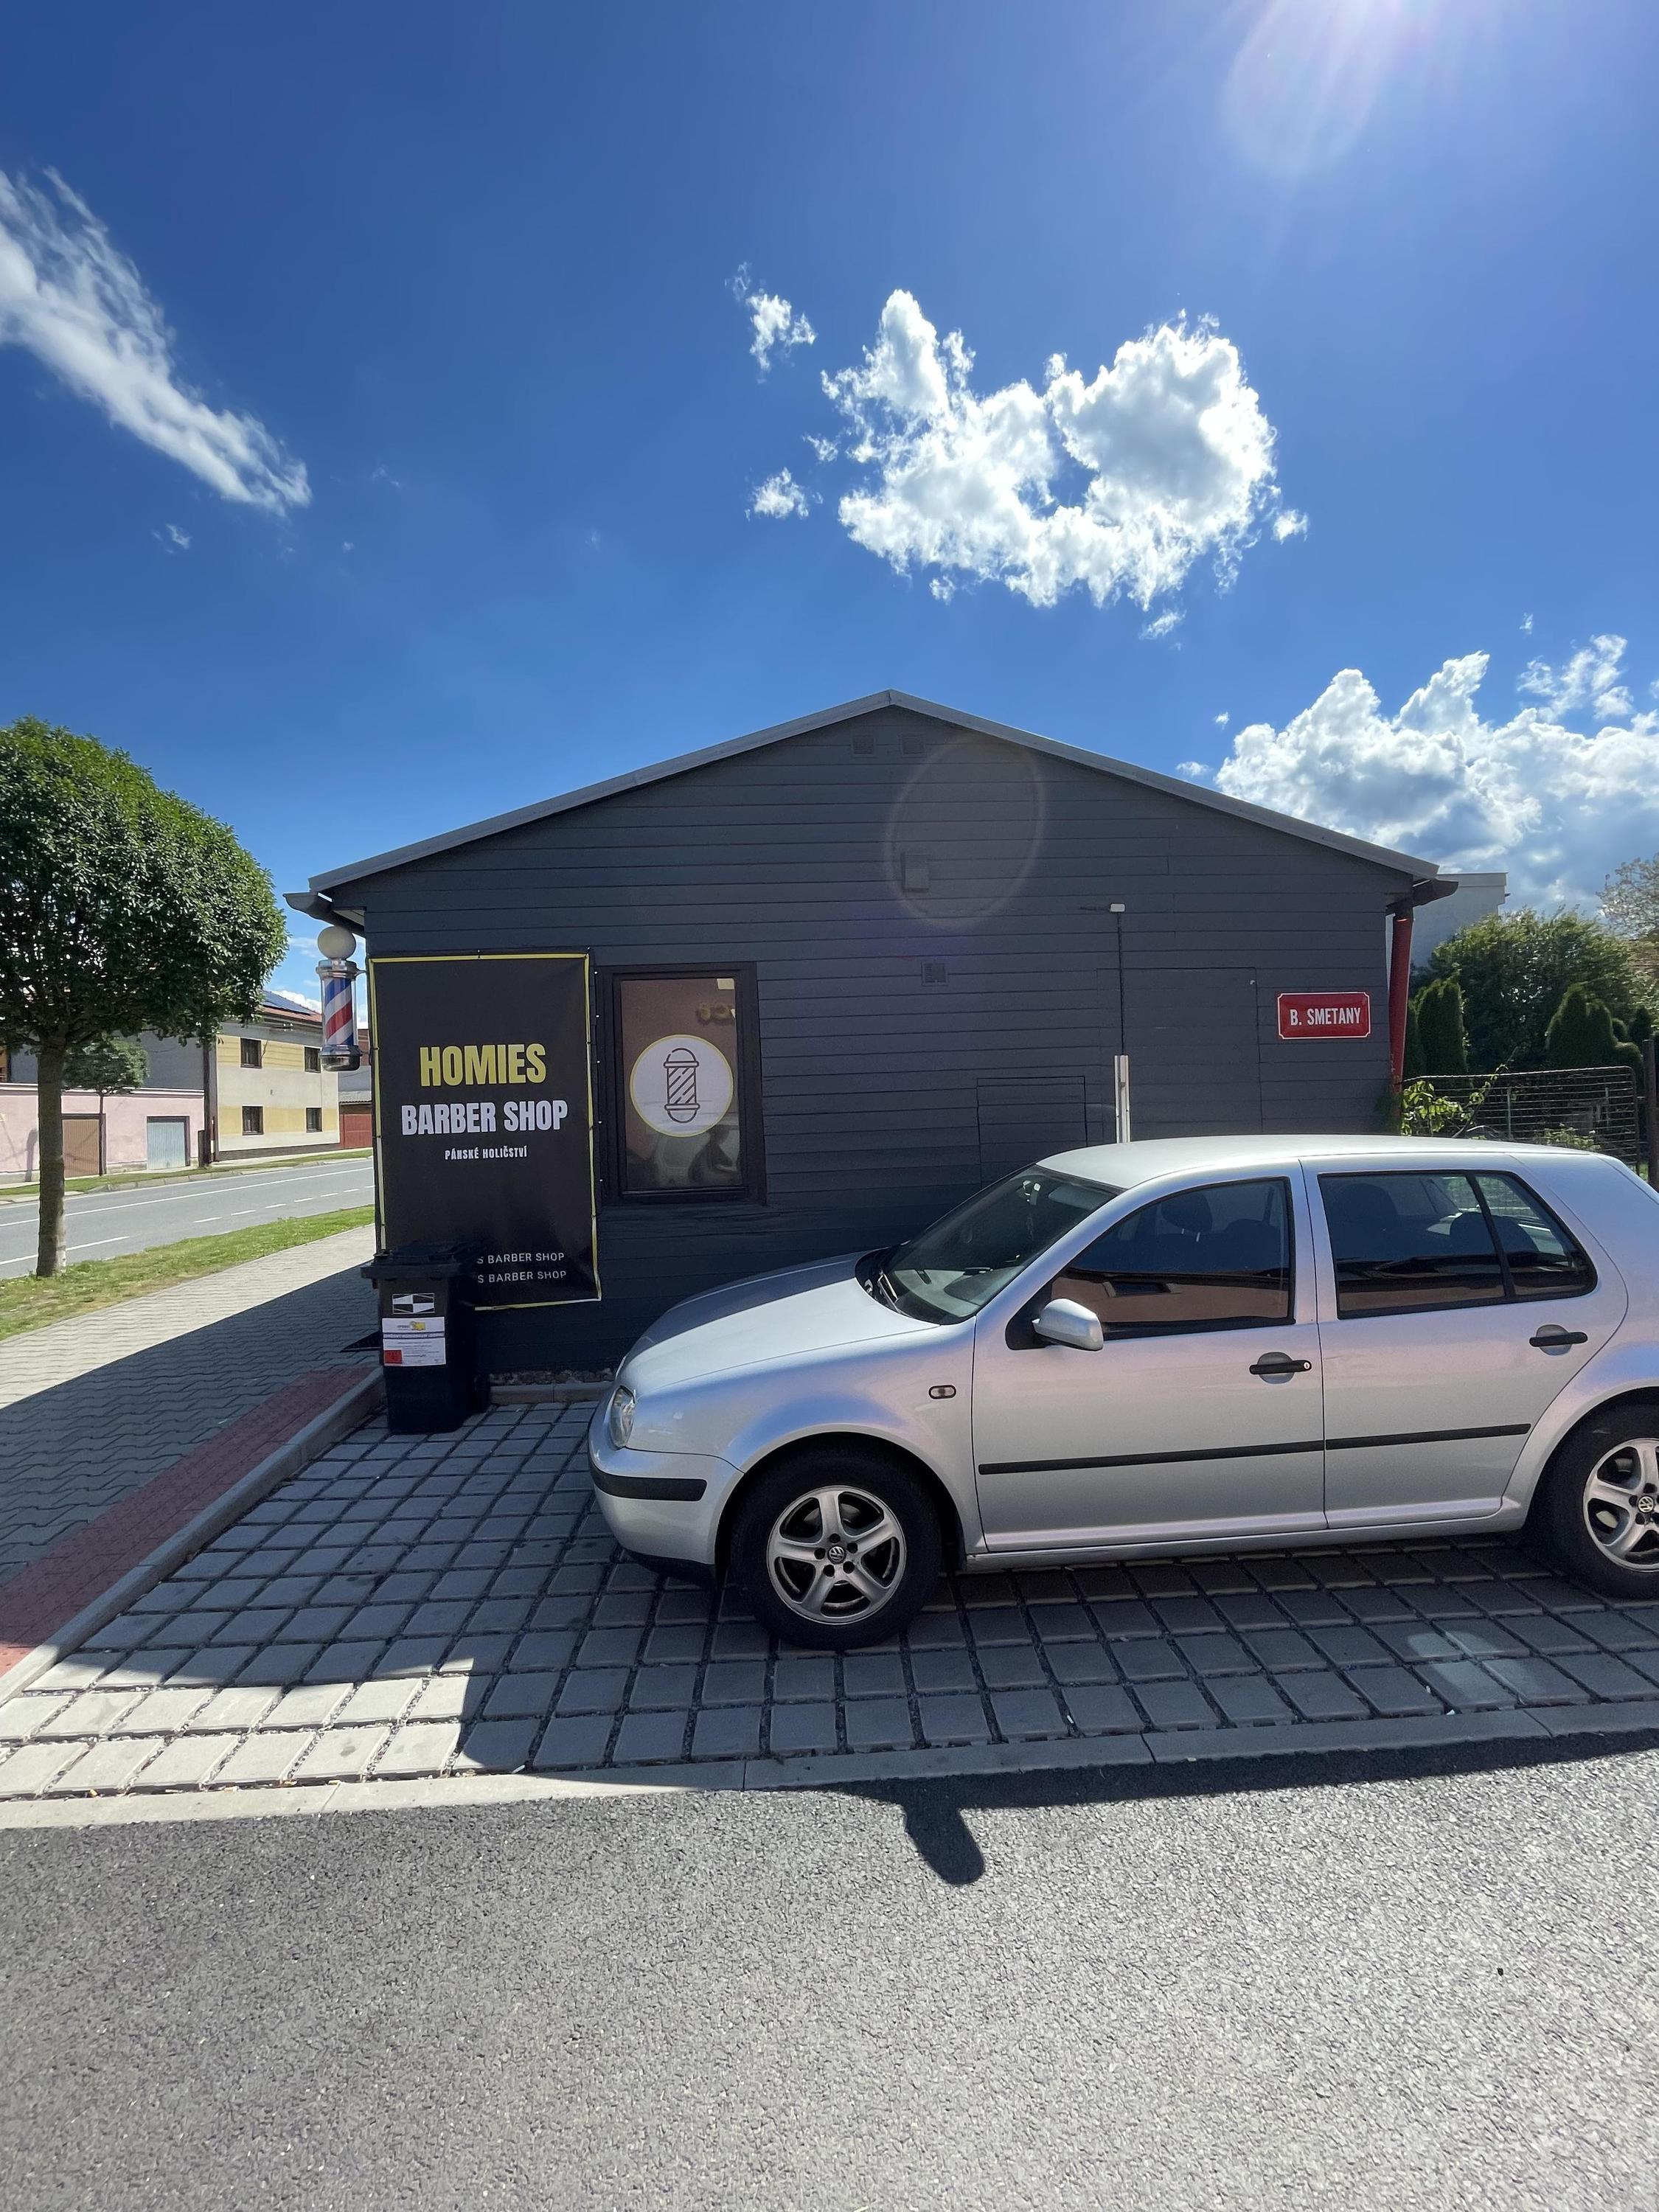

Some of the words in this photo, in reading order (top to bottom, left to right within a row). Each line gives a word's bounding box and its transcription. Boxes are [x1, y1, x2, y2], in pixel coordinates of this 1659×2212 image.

[1290, 1009, 1302, 1026] B.
[1307, 1007, 1361, 1026] SMETANY
[420, 1043, 546, 1087] HOMIES
[401, 1102, 496, 1135] BARBER
[504, 1099, 568, 1132] SHOP
[445, 1147, 479, 1160] PÁNSKÉ
[482, 1145, 527, 1158] HOLIČSTVÍ
[487, 1253, 532, 1264] BARBER
[535, 1252, 565, 1262] SHOP
[488, 1271, 533, 1283] BARBER
[537, 1270, 567, 1279] SHOP
